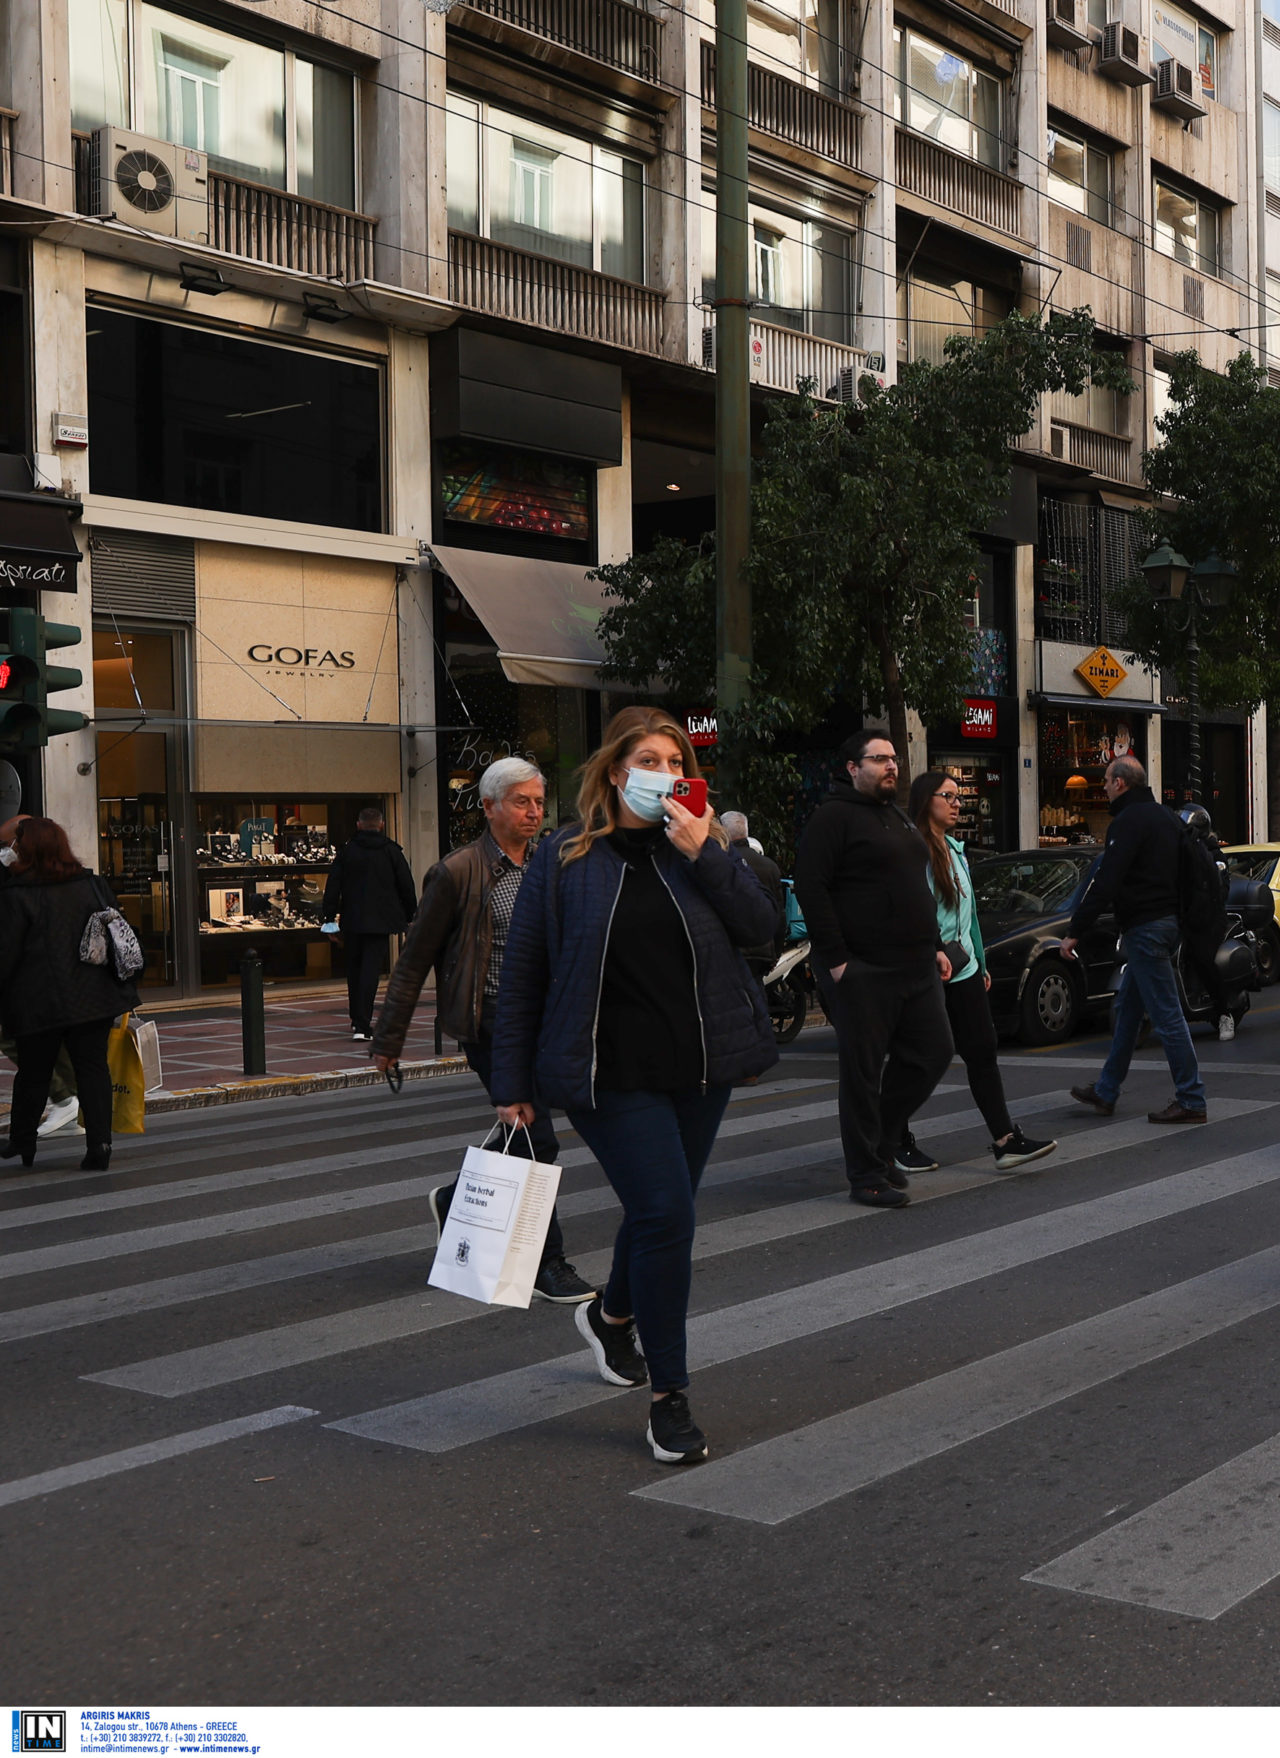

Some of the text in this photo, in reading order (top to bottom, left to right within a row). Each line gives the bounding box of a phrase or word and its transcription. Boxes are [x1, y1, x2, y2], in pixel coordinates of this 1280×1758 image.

[247, 644, 355, 669] GOFAS
[265, 670, 335, 678] JEWELRY
[1089, 666, 1119, 678] ZIMARI
[687, 716, 718, 734] LEGAM
[110, 824, 159, 834] GOFAS
